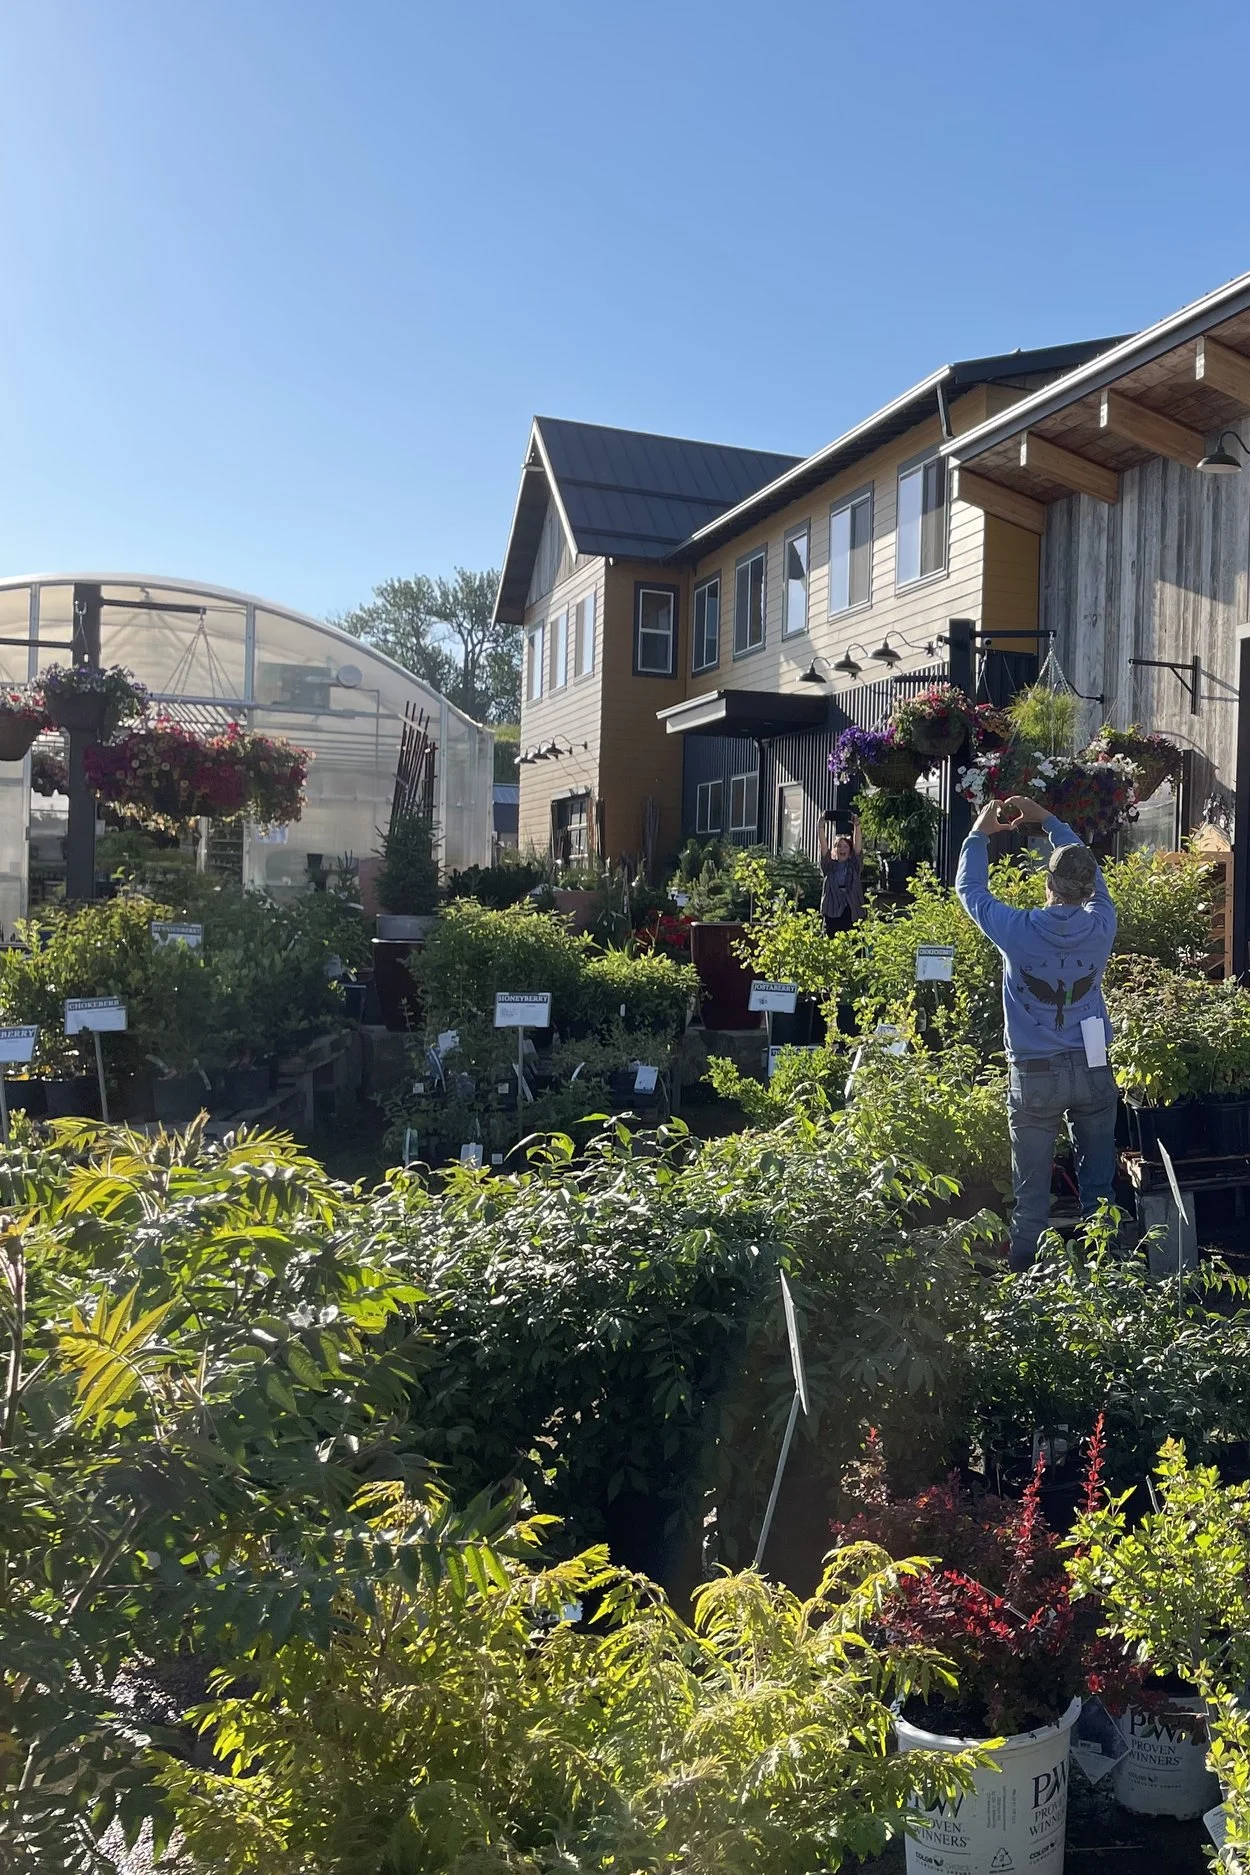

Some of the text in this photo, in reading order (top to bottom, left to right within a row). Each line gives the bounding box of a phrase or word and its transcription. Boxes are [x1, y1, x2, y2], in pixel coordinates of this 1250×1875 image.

[754, 984, 795, 992] JOSTABERRY
[69, 1000, 120, 1010] CHOKEBERR
[1131, 1738, 1176, 1754] PROVEN
[1129, 1751, 1180, 1766] WINNERS
